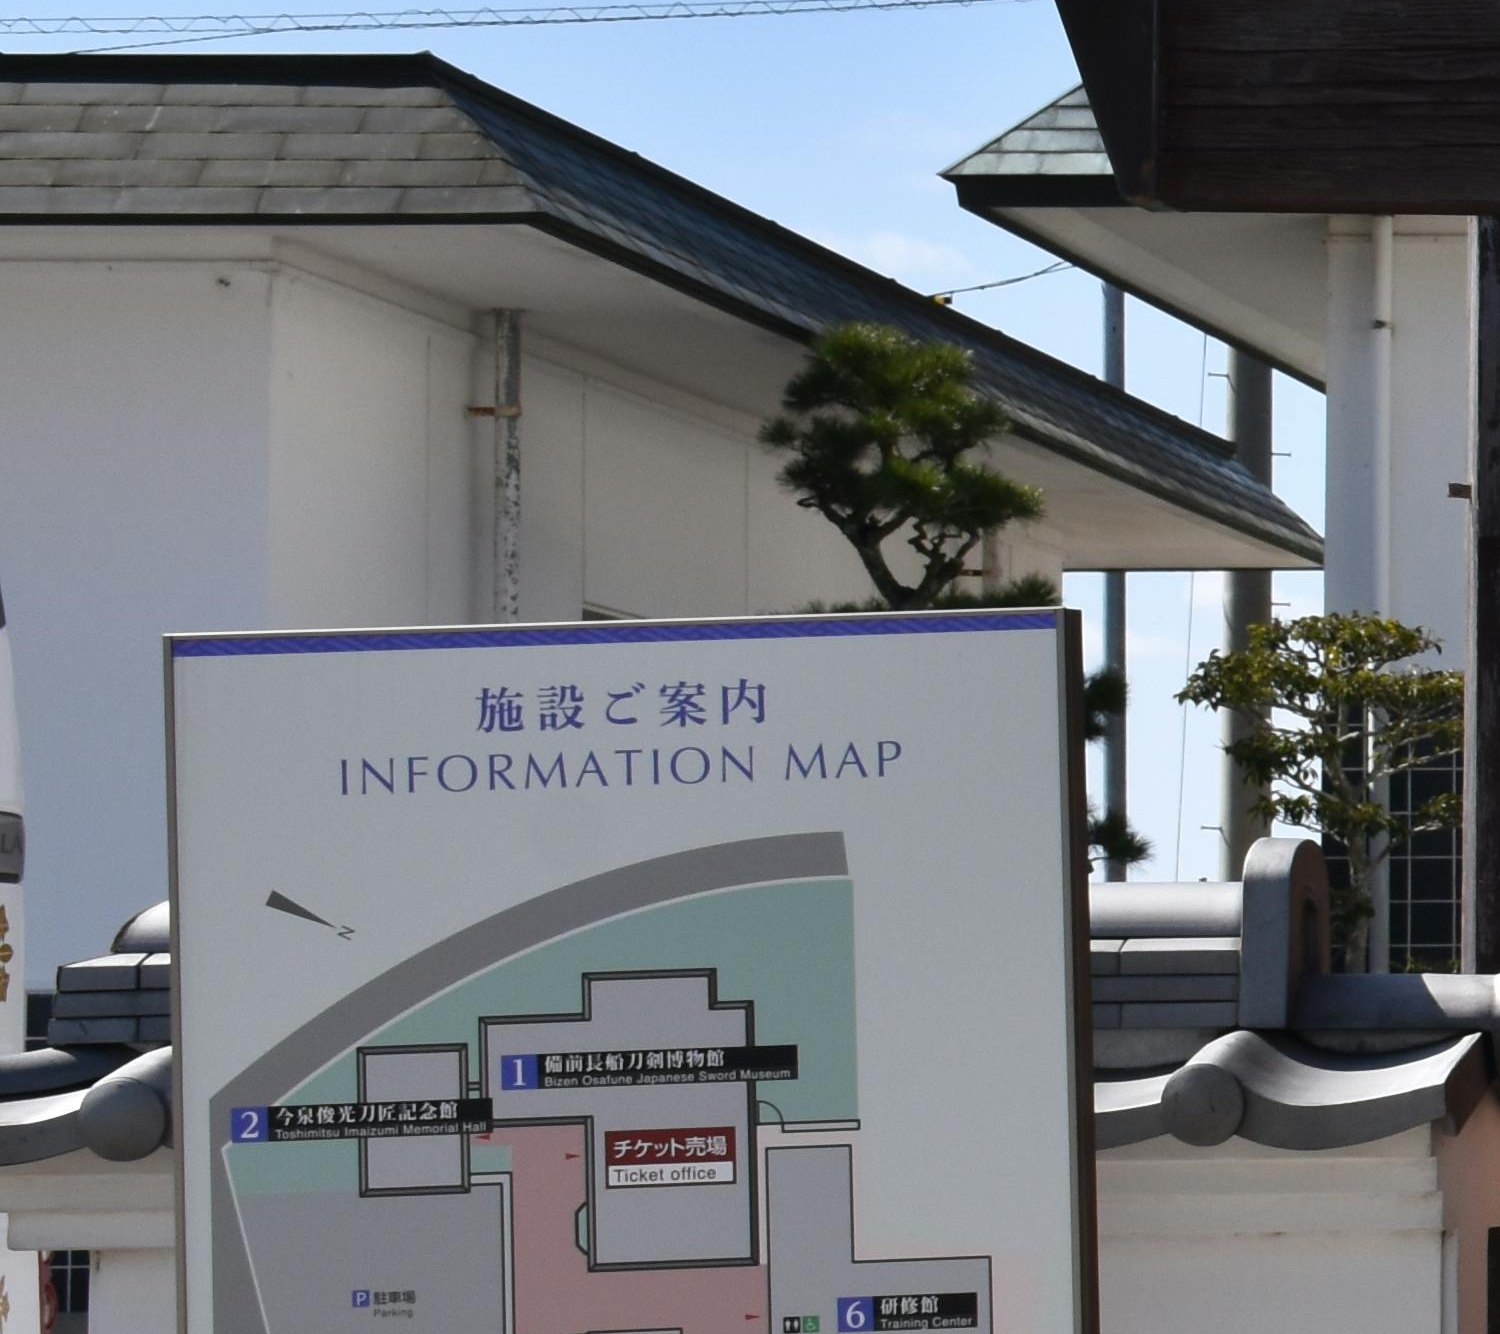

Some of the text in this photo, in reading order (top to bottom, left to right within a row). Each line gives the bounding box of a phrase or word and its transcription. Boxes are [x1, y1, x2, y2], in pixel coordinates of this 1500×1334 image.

[475, 677, 768, 734] 施設ご案内
[339, 739, 903, 796] INFORMATION MAP
[511, 1058, 528, 1087] 1
[545, 1049, 725, 1074] 備前長船刀剣博物館
[544, 1068, 792, 1087] Bizen Osafune Japanese Sword Museum
[239, 1111, 260, 1139] 2
[276, 1100, 459, 1127] 今泉俊光刀匠記念館
[275, 1120, 488, 1140] Toshimitsu Imaizumi Memorial Hall
[612, 1135, 728, 1159] チケット売場
[612, 1165, 717, 1184] Ticket office
[373, 1289, 416, 1306] 駐車場
[880, 1295, 940, 1316] 研修館
[373, 1307, 414, 1319] Parking
[845, 1300, 866, 1329] 6
[880, 1316, 973, 1330] Training Center
